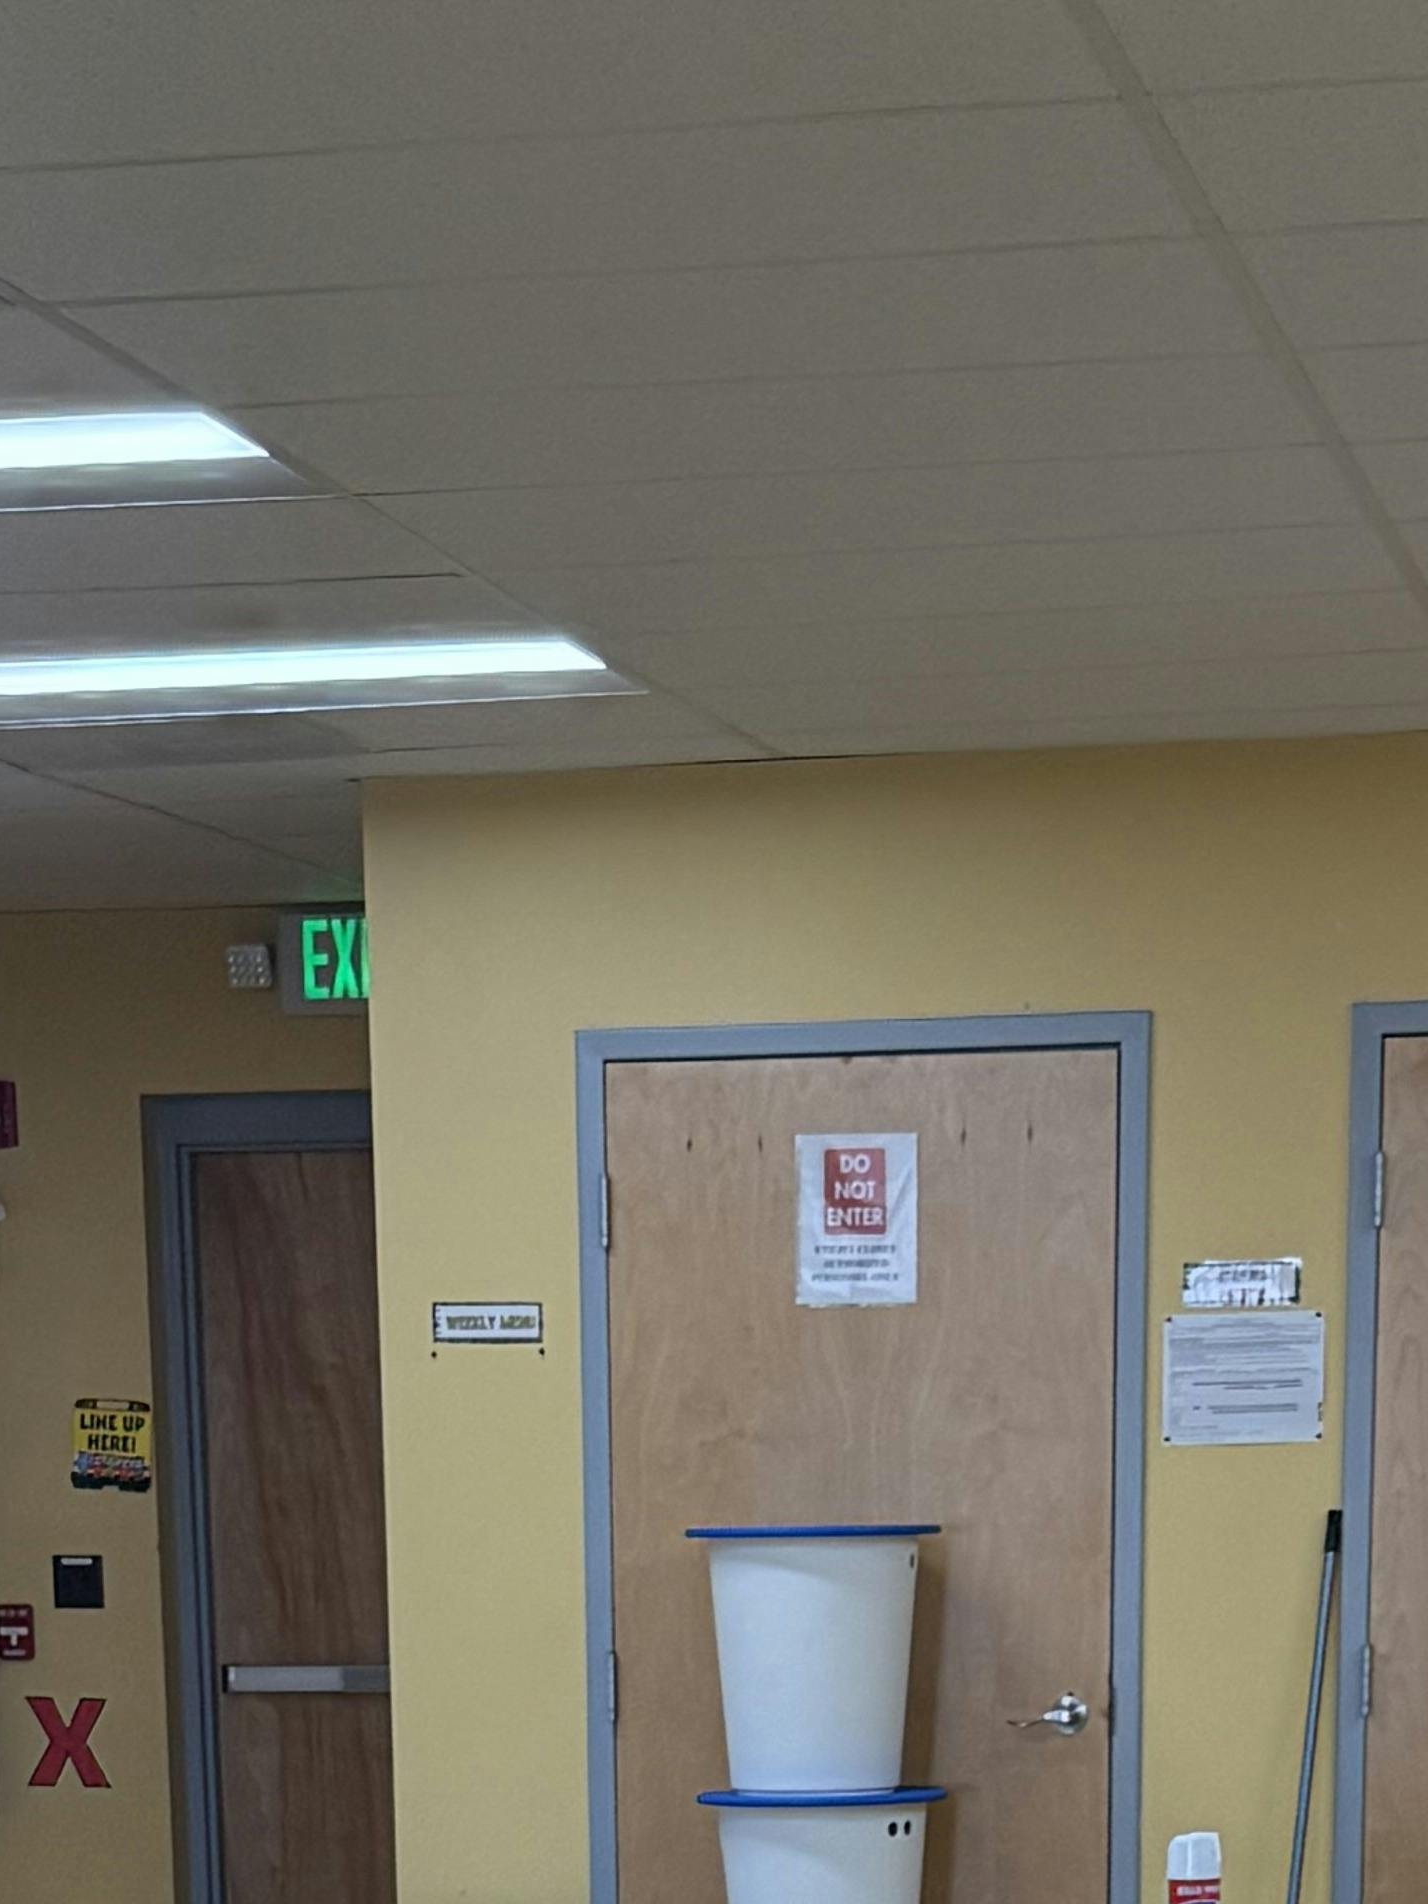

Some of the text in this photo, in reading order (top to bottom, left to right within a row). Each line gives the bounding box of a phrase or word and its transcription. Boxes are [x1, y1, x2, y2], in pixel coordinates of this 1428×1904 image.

[302, 918, 369, 1000] EXI
[839, 1154, 871, 1173] DO
[834, 1181, 876, 1200] NOT
[826, 1207, 884, 1226] ENTER
[80, 1413, 145, 1432] LINE UP
